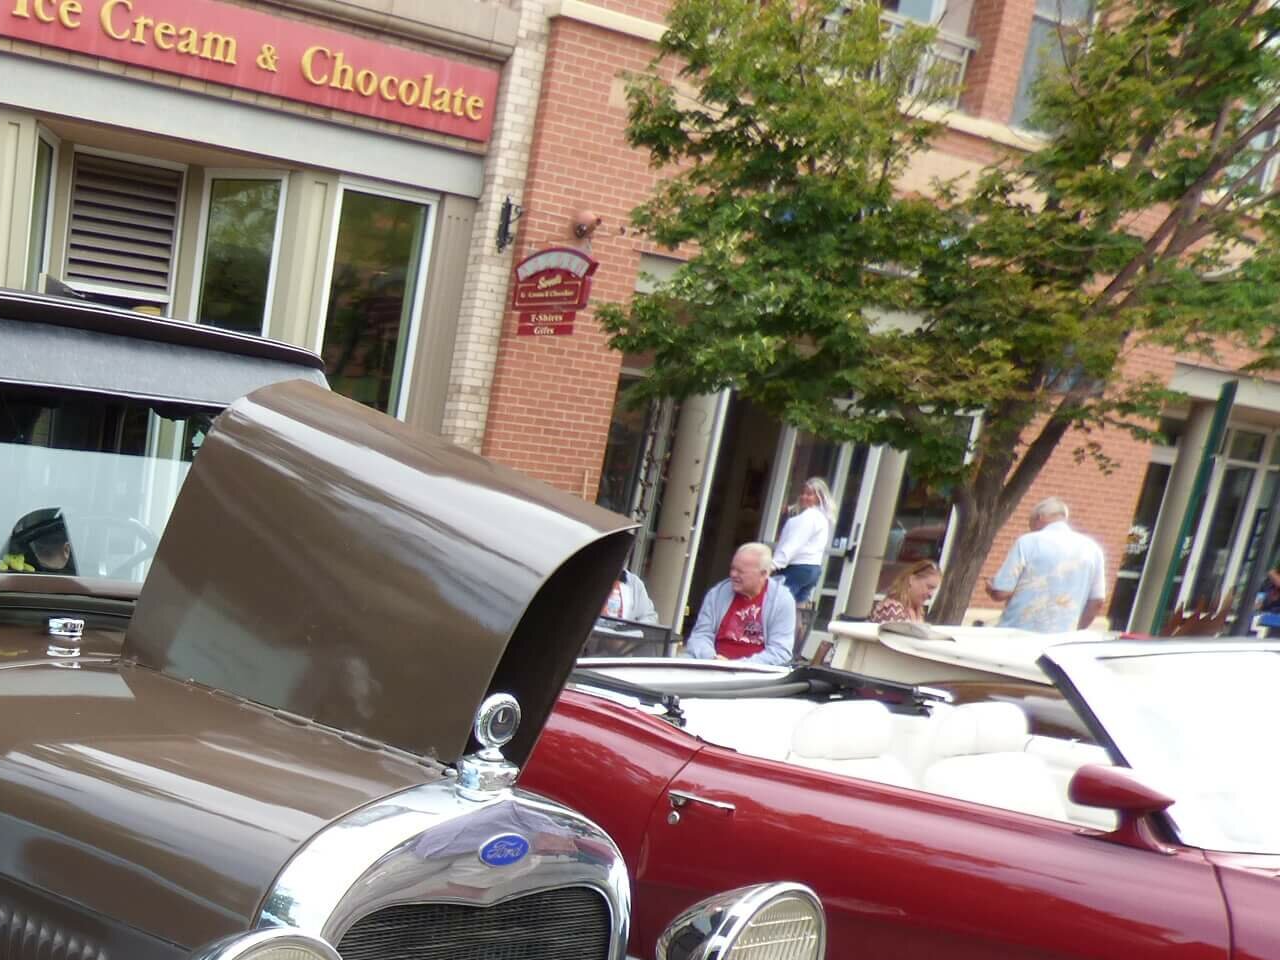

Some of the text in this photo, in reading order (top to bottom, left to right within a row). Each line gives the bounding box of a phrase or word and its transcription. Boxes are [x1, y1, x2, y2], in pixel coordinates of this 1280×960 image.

[11, 0, 83, 29] Ice
[99, 0, 237, 65] Cream
[256, 44, 279, 72] &
[300, 46, 486, 121] Chocolate
[486, 840, 524, 860] Ford
